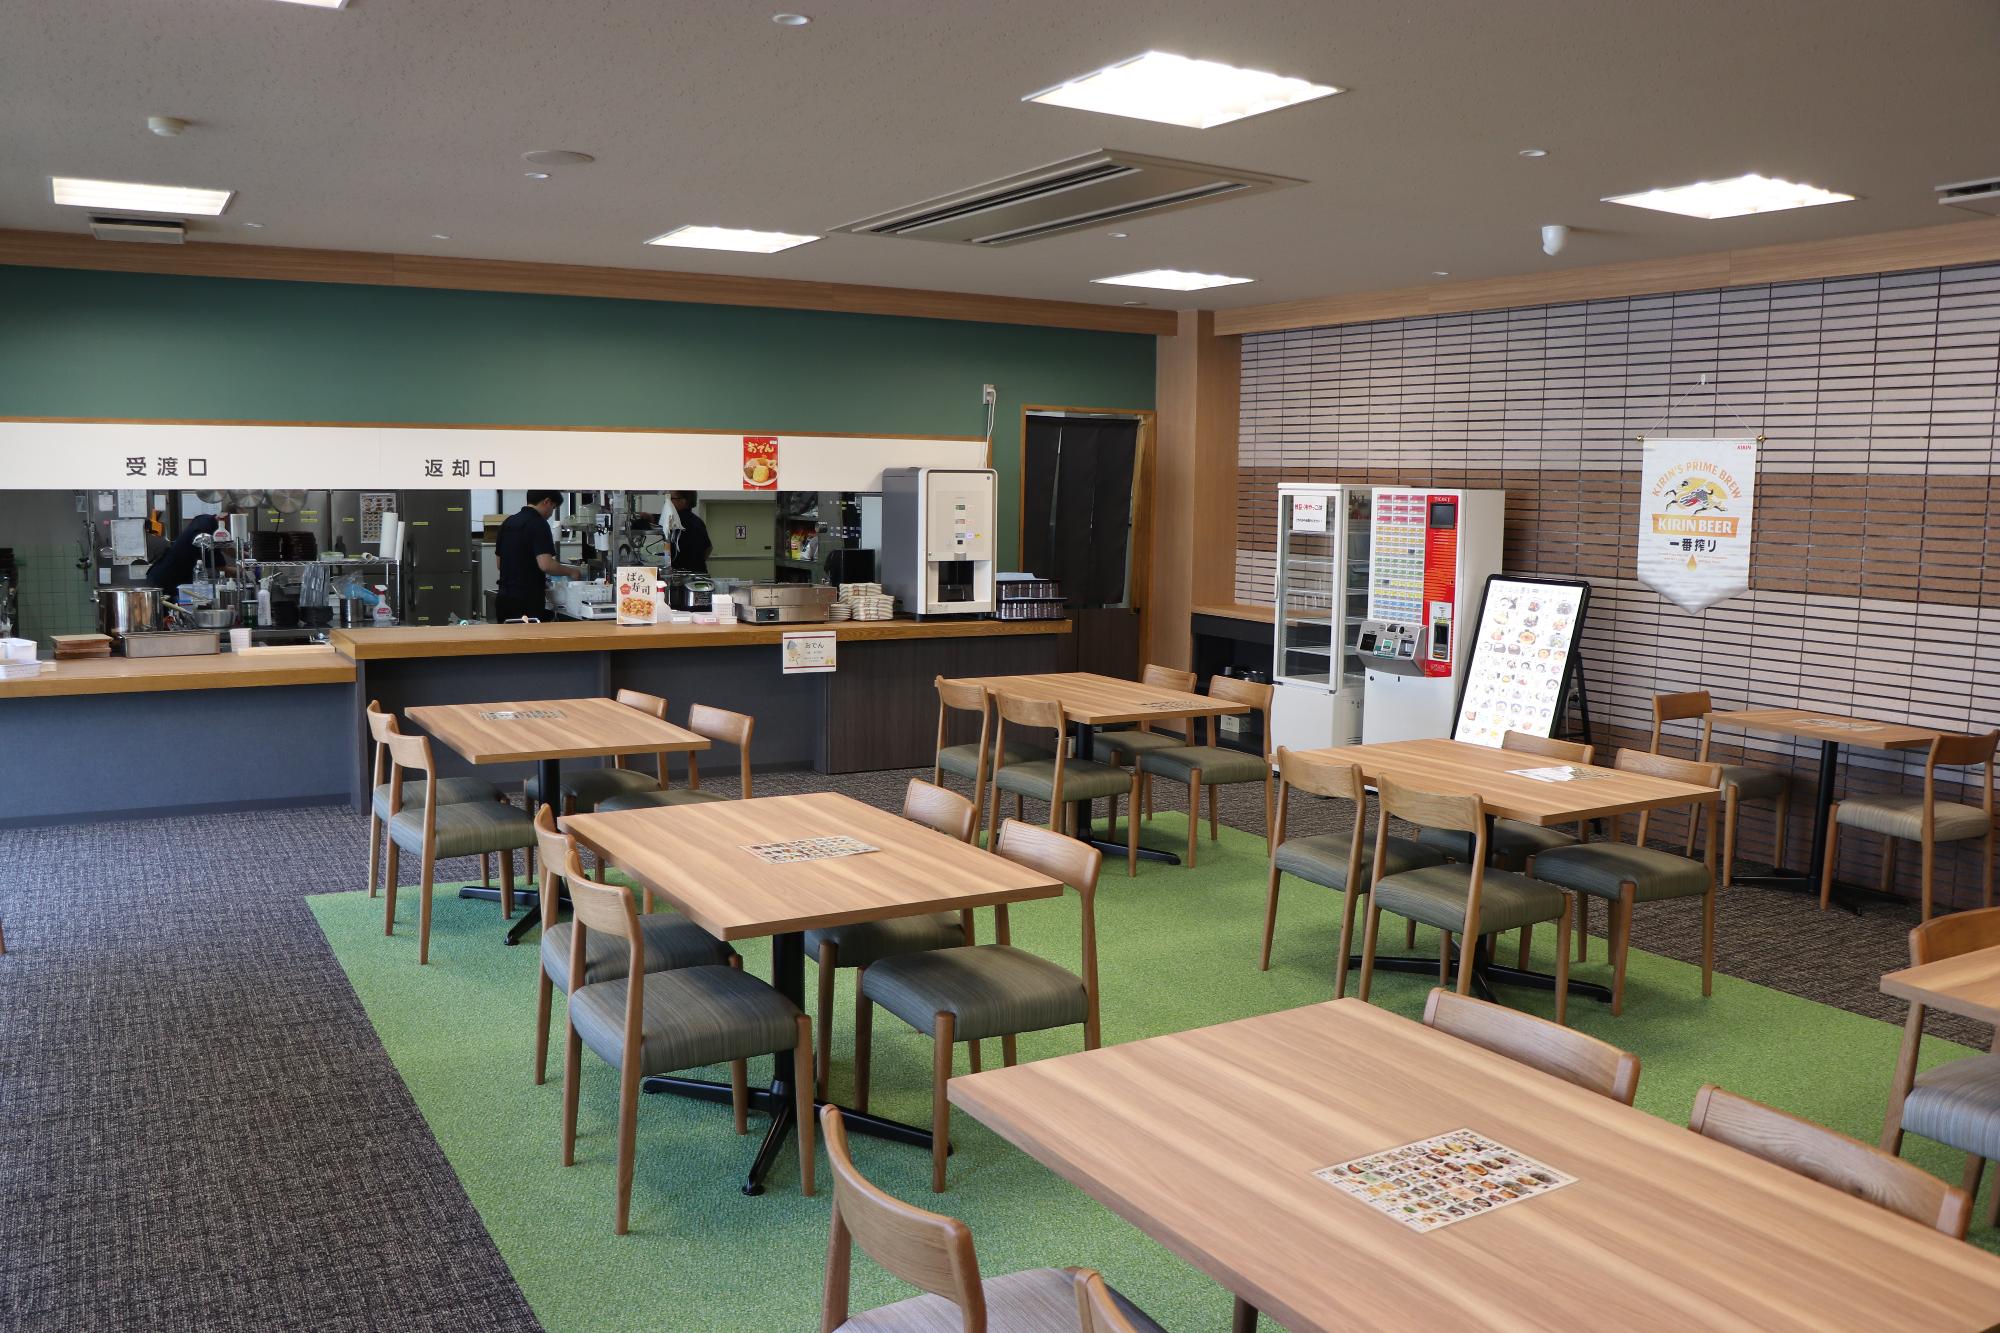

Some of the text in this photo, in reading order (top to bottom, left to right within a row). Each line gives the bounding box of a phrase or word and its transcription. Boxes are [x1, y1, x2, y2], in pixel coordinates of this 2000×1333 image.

[746, 441, 774, 453] おでん
[126, 457, 207, 476] 受渡口
[425, 459, 495, 477] 返却口
[1652, 461, 1743, 500] KIRIN'S PRIME BREW
[1659, 518, 1732, 534] KIRIN BEER
[1669, 538, 1717, 553] 一番搾り
[626, 572, 645, 583] ばら
[631, 583, 650, 595] 寿司
[805, 641, 824, 649] おでん
